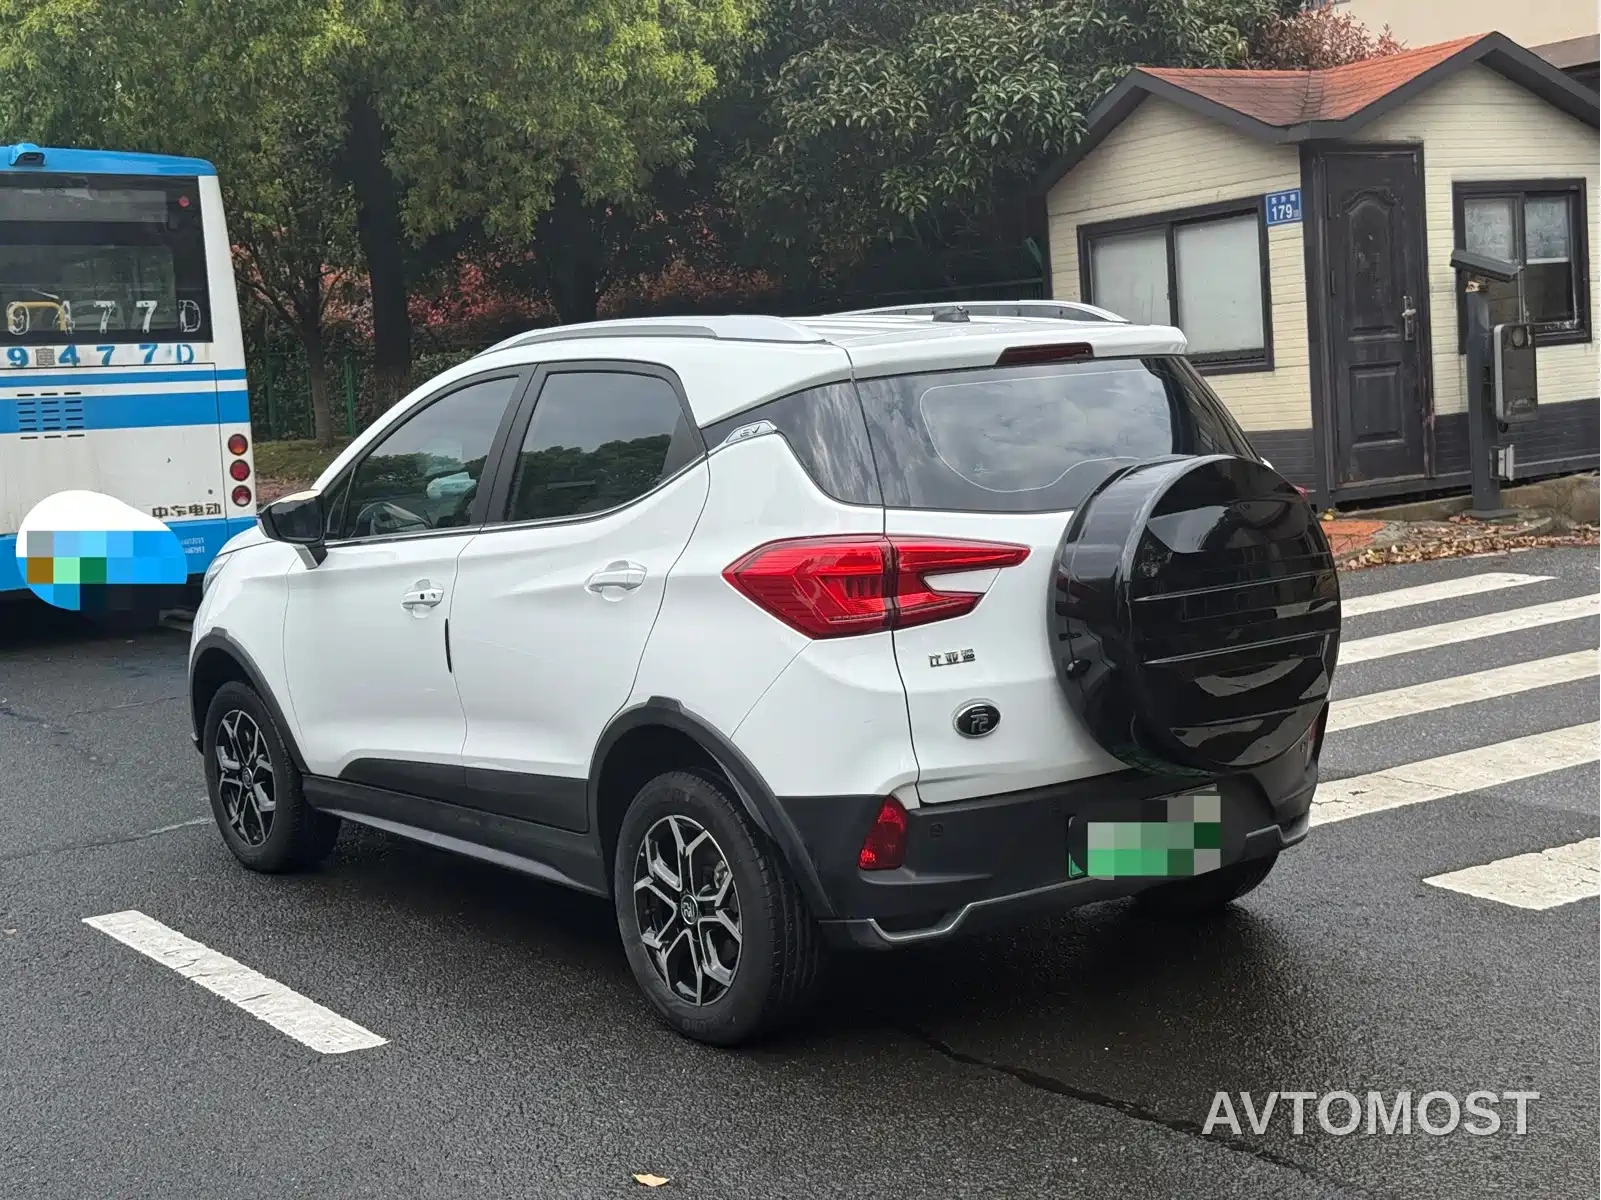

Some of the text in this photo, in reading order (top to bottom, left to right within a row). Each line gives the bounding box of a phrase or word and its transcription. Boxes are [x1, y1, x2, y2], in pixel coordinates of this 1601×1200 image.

[1271, 204, 1293, 221] 179
[740, 425, 761, 438] EV
[152, 502, 222, 520] 中车电动
